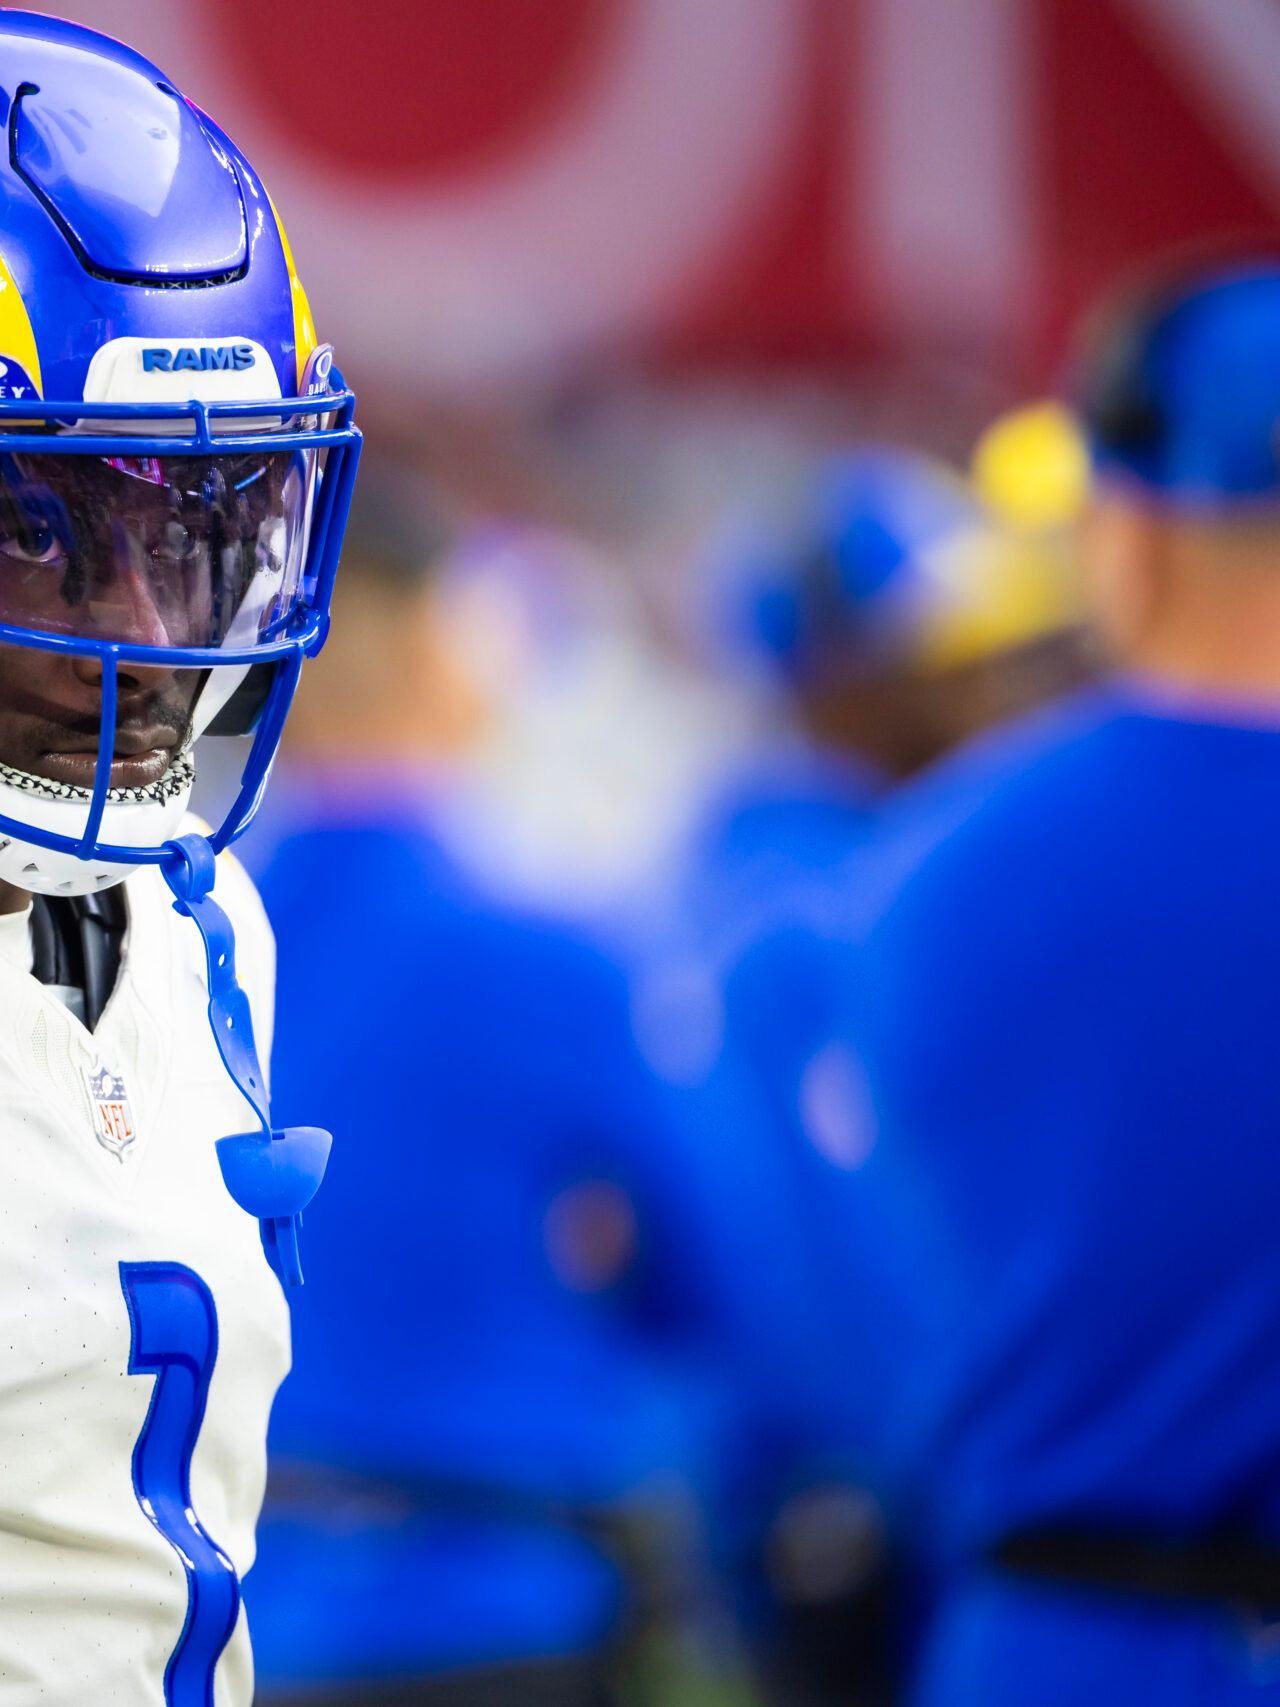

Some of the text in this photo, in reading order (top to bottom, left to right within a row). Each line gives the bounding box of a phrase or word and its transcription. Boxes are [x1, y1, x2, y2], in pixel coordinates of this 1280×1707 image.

[142, 345, 256, 372] RAMS
[308, 382, 326, 396] OAK
[99, 1103, 132, 1141] NFL
[118, 1260, 240, 1707] 1
